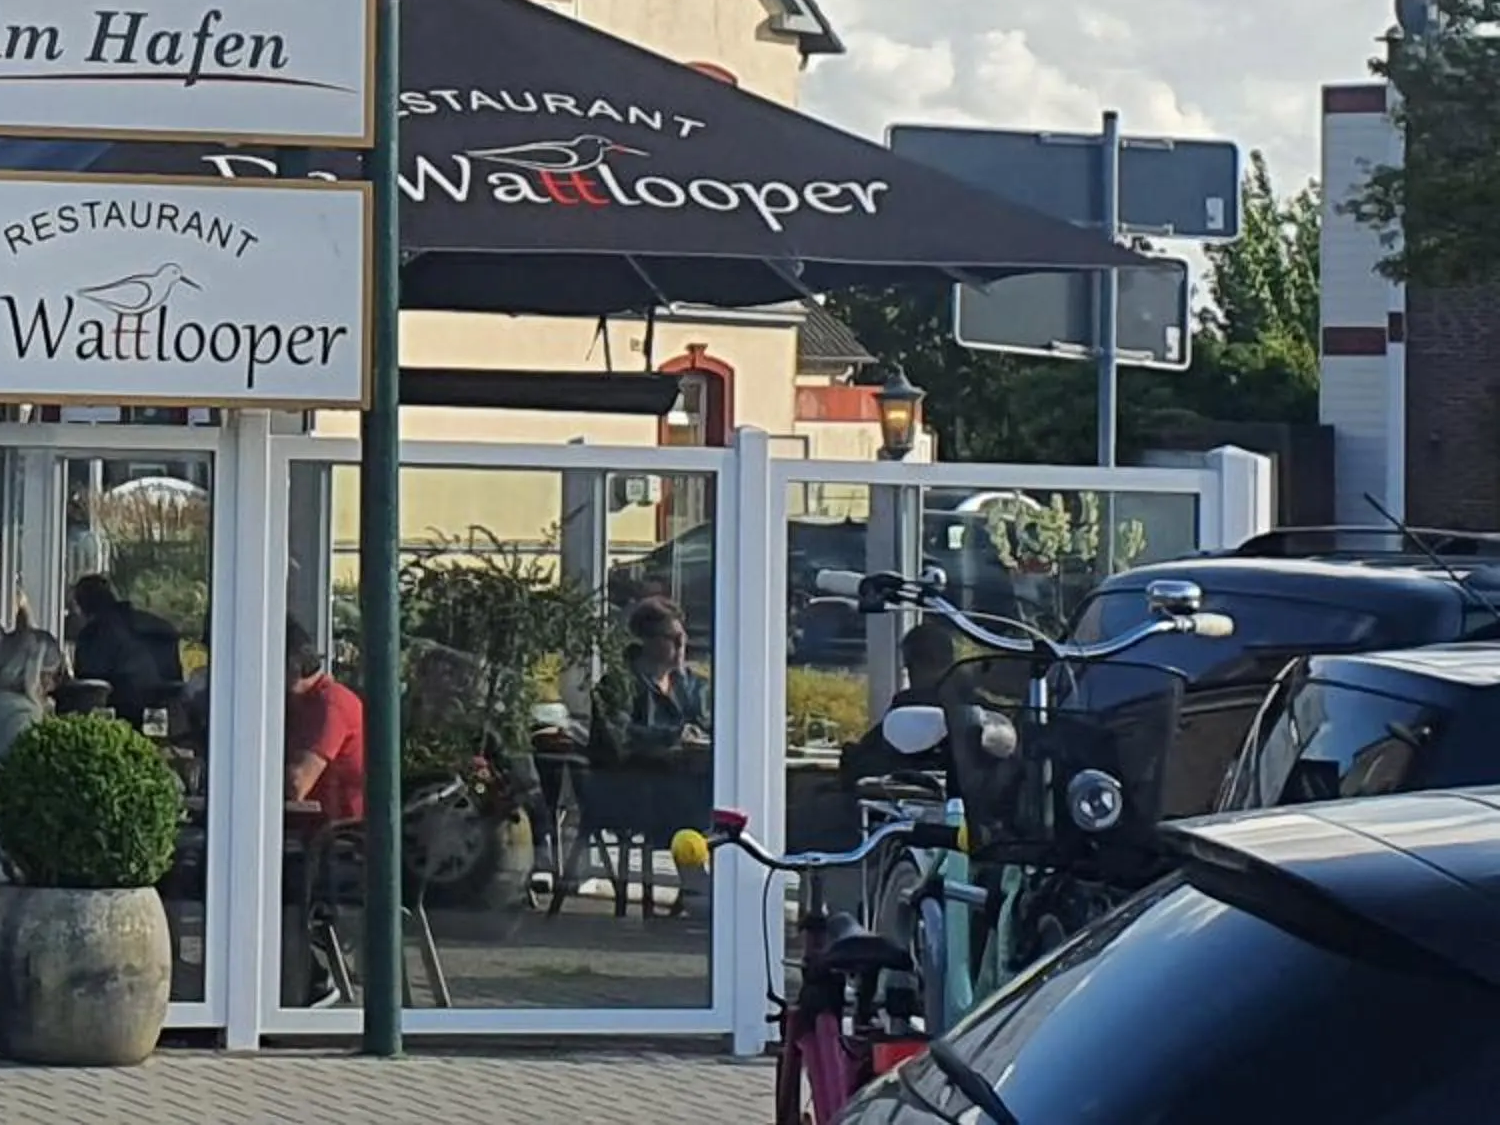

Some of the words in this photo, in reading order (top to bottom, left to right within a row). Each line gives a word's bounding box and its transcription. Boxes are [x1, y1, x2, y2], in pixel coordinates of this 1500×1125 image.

[84, 9, 290, 88] Hafen
[397, 89, 706, 139] STAURANT
[2, 200, 260, 256] RESTAURANT
[0, 295, 349, 389] Wattlooper
